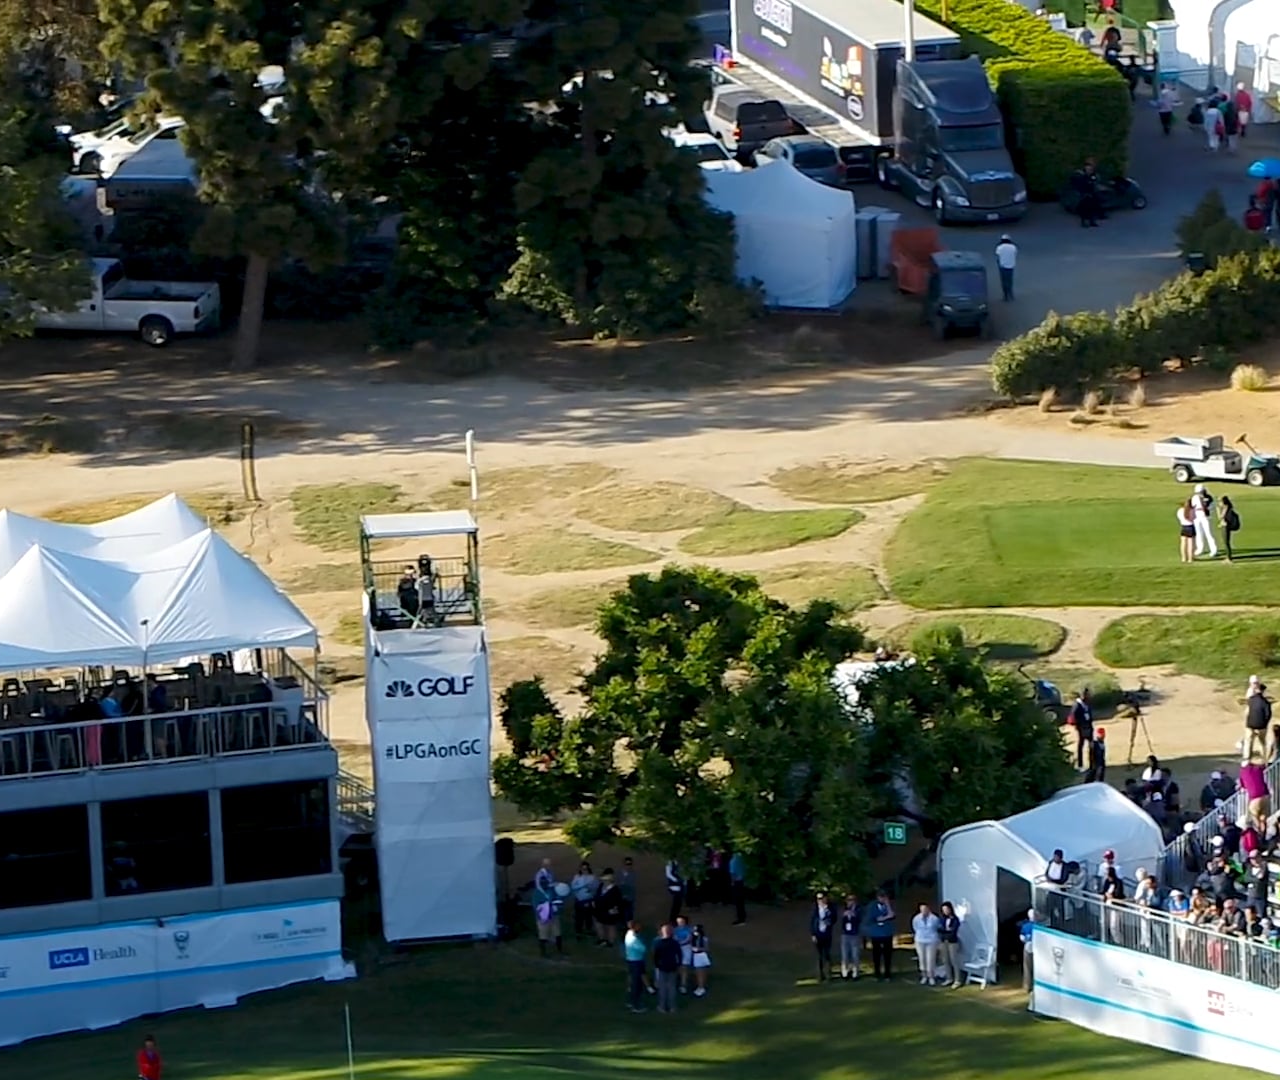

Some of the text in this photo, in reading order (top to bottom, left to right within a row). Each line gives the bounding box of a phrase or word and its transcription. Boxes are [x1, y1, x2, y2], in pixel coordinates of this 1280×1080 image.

[418, 675, 474, 697] GOLF
[385, 739, 481, 760] #LPGAonGC
[887, 827, 903, 839] 18
[53, 946, 137, 965] UCLA Health
